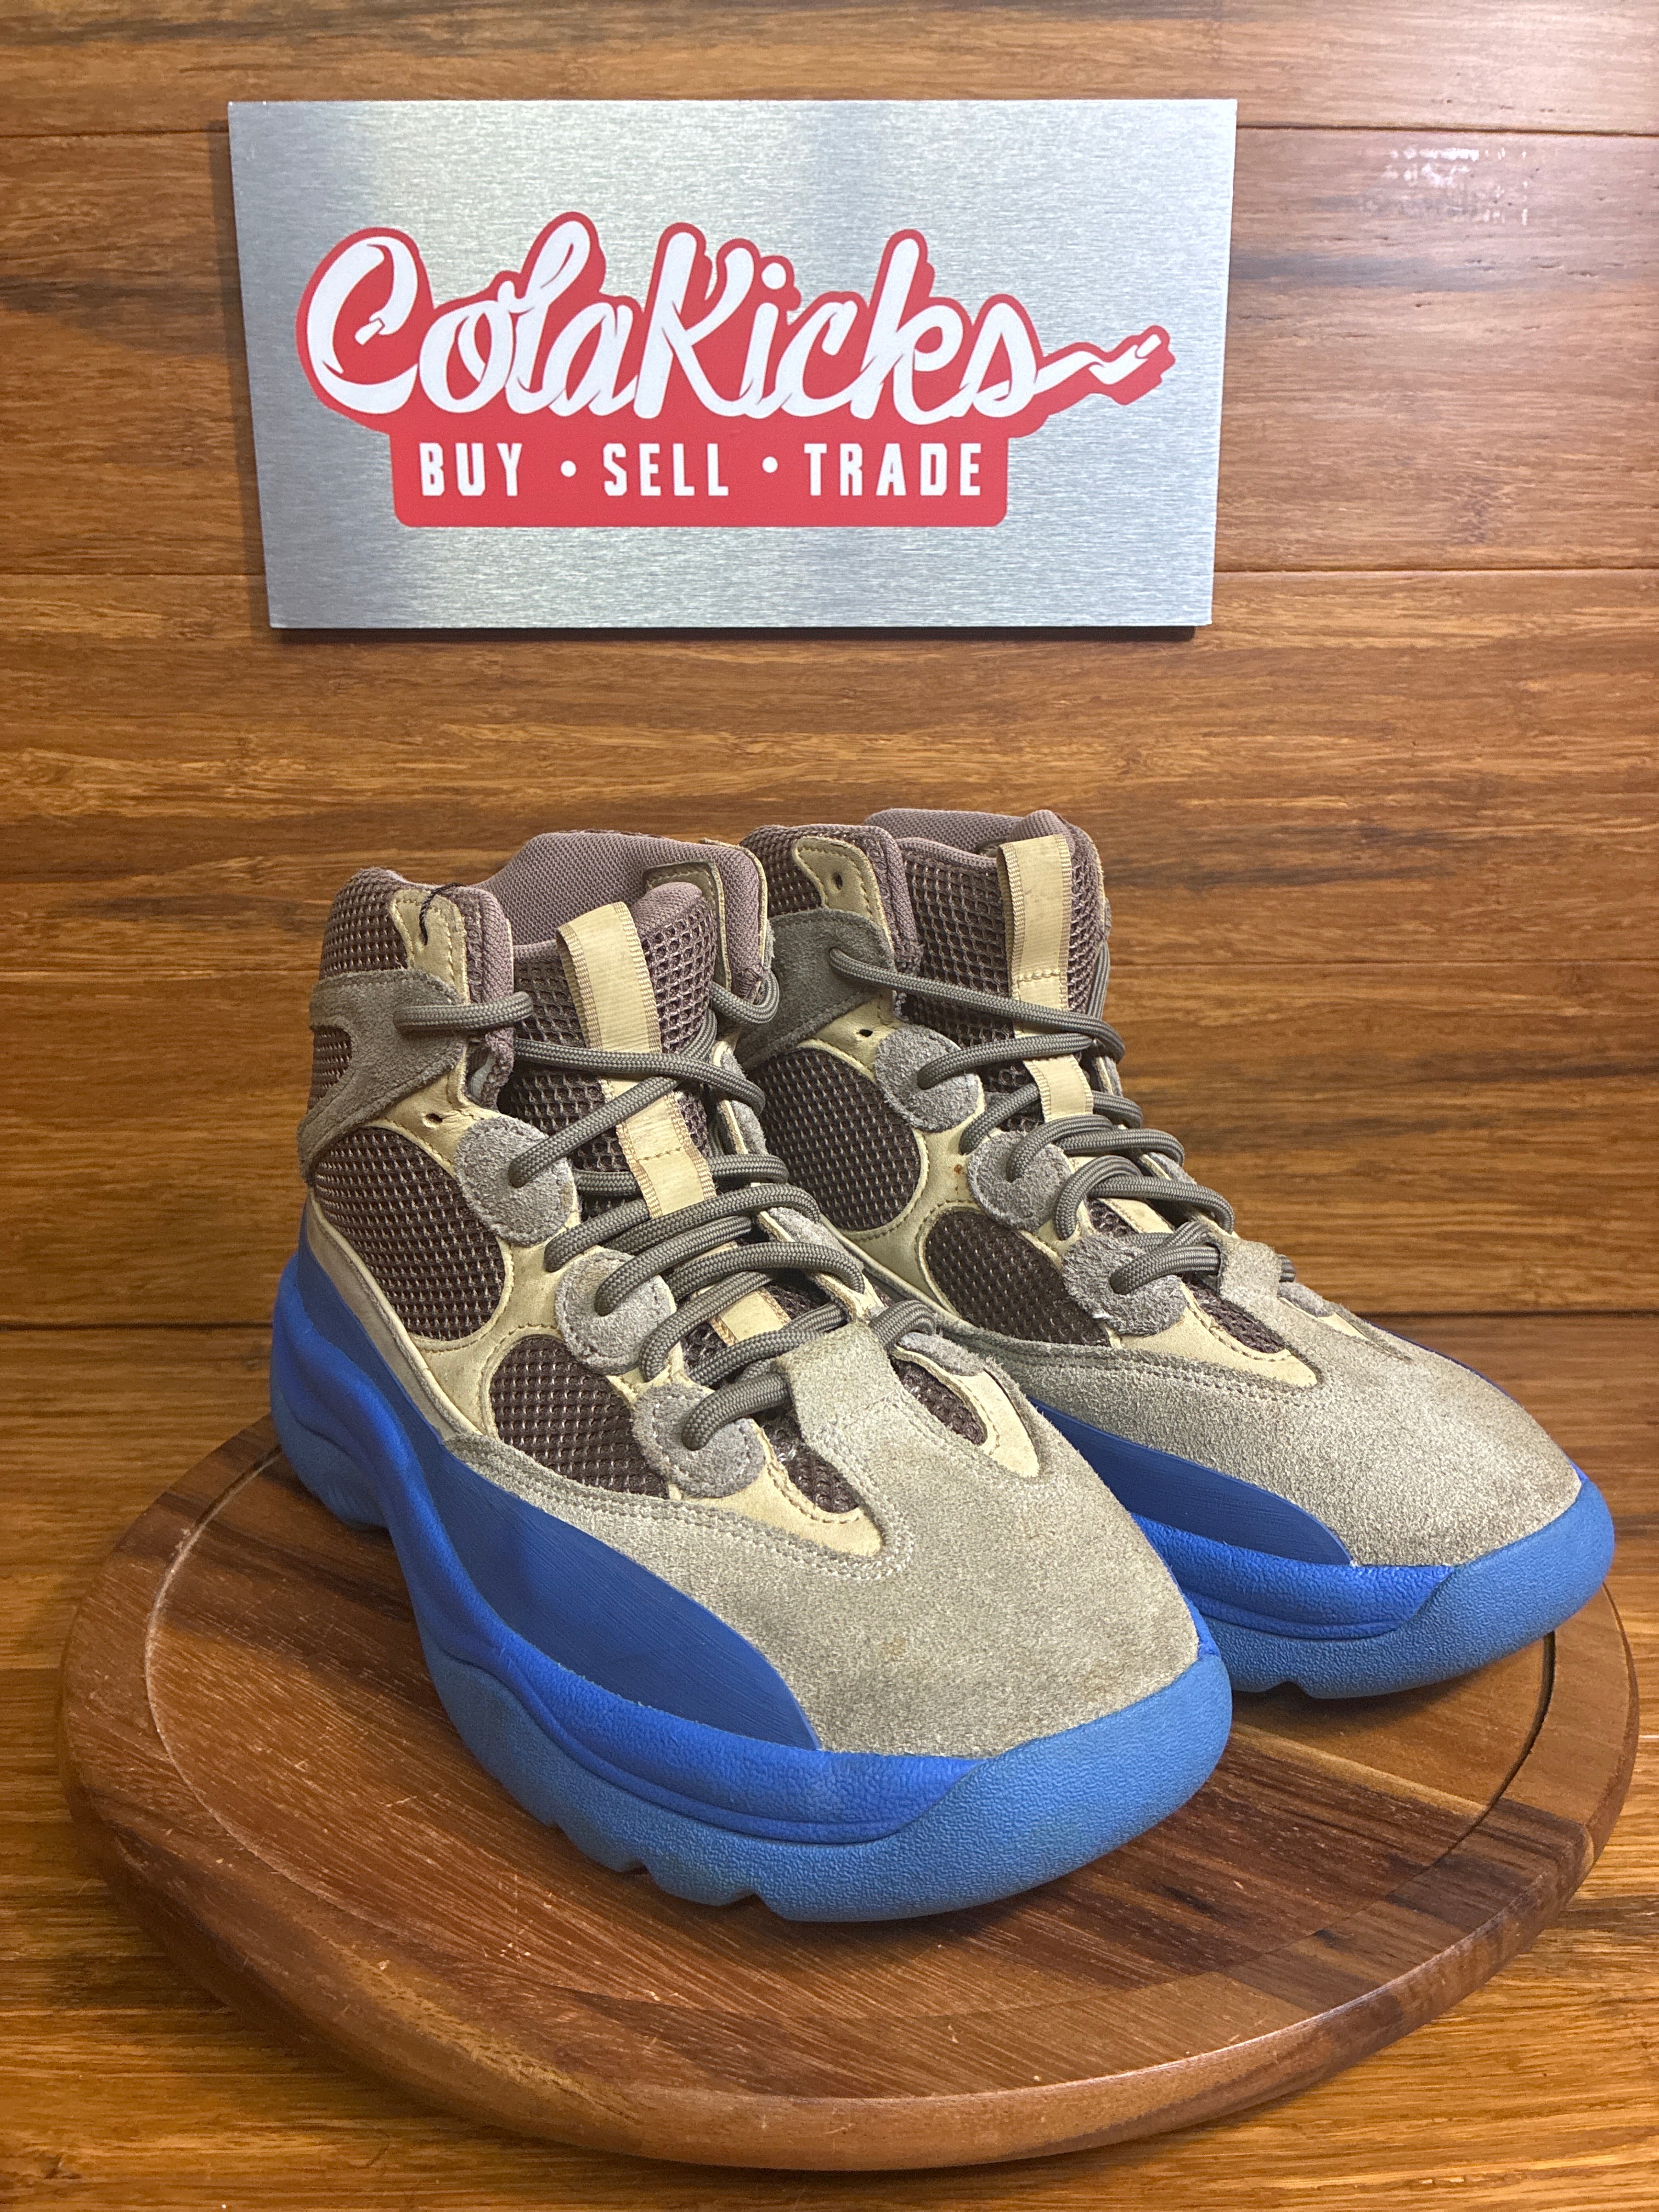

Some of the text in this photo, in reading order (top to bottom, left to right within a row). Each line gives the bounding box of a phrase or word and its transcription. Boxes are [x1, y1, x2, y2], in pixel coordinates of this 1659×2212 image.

[306, 219, 1162, 426] ColaKicks
[419, 442, 982, 497] BUY SELL TRADE
